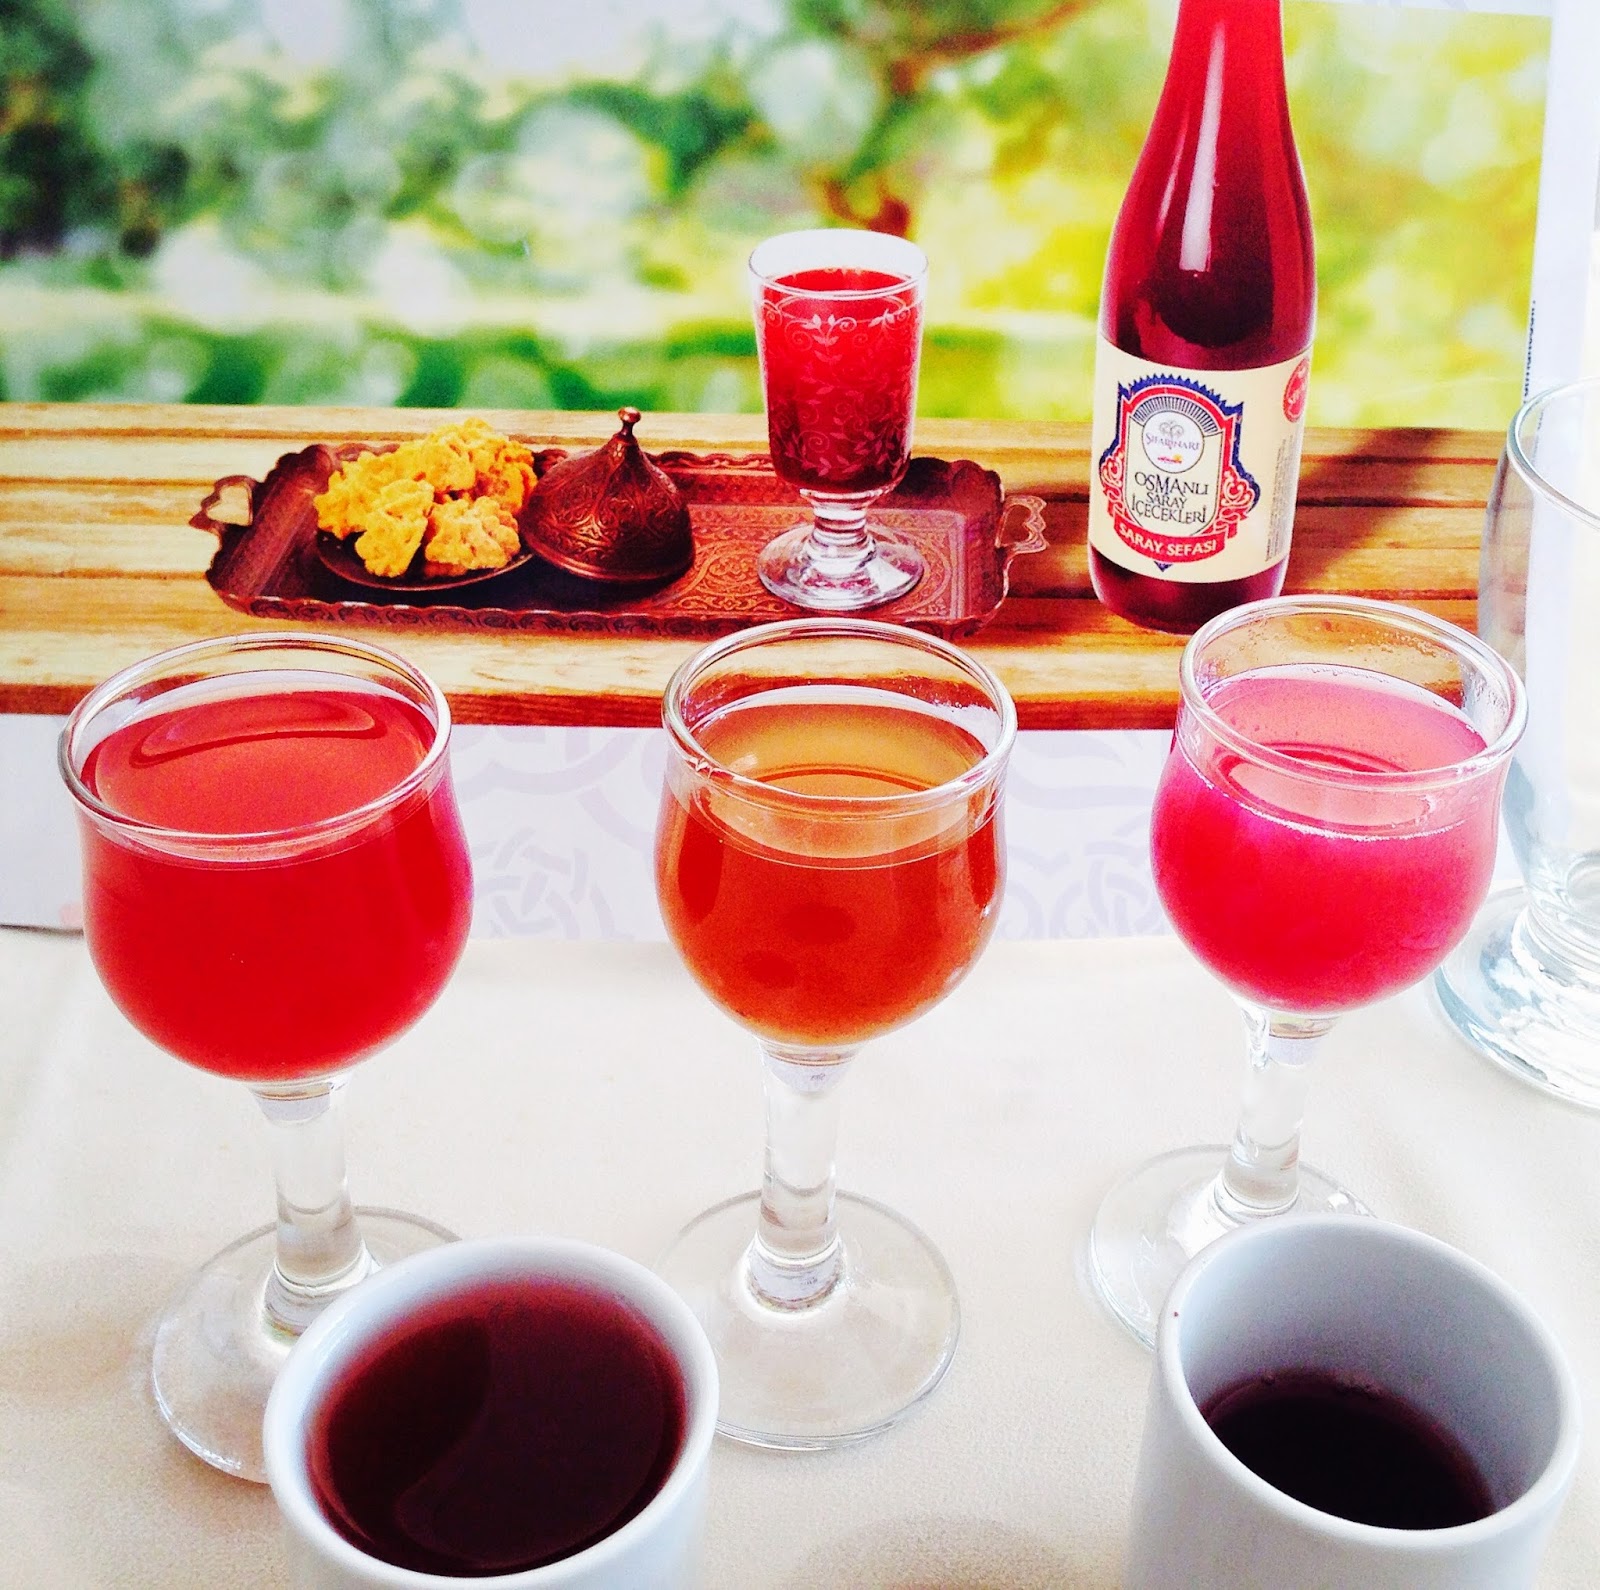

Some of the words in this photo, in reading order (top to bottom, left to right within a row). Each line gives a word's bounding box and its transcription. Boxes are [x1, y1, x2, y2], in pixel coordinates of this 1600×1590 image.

[1134, 471, 1209, 497] OSMANLI
[1146, 491, 1188, 509] SARAY
[1119, 522, 1163, 554] SARAY
[1166, 539, 1217, 556] SEFASI
